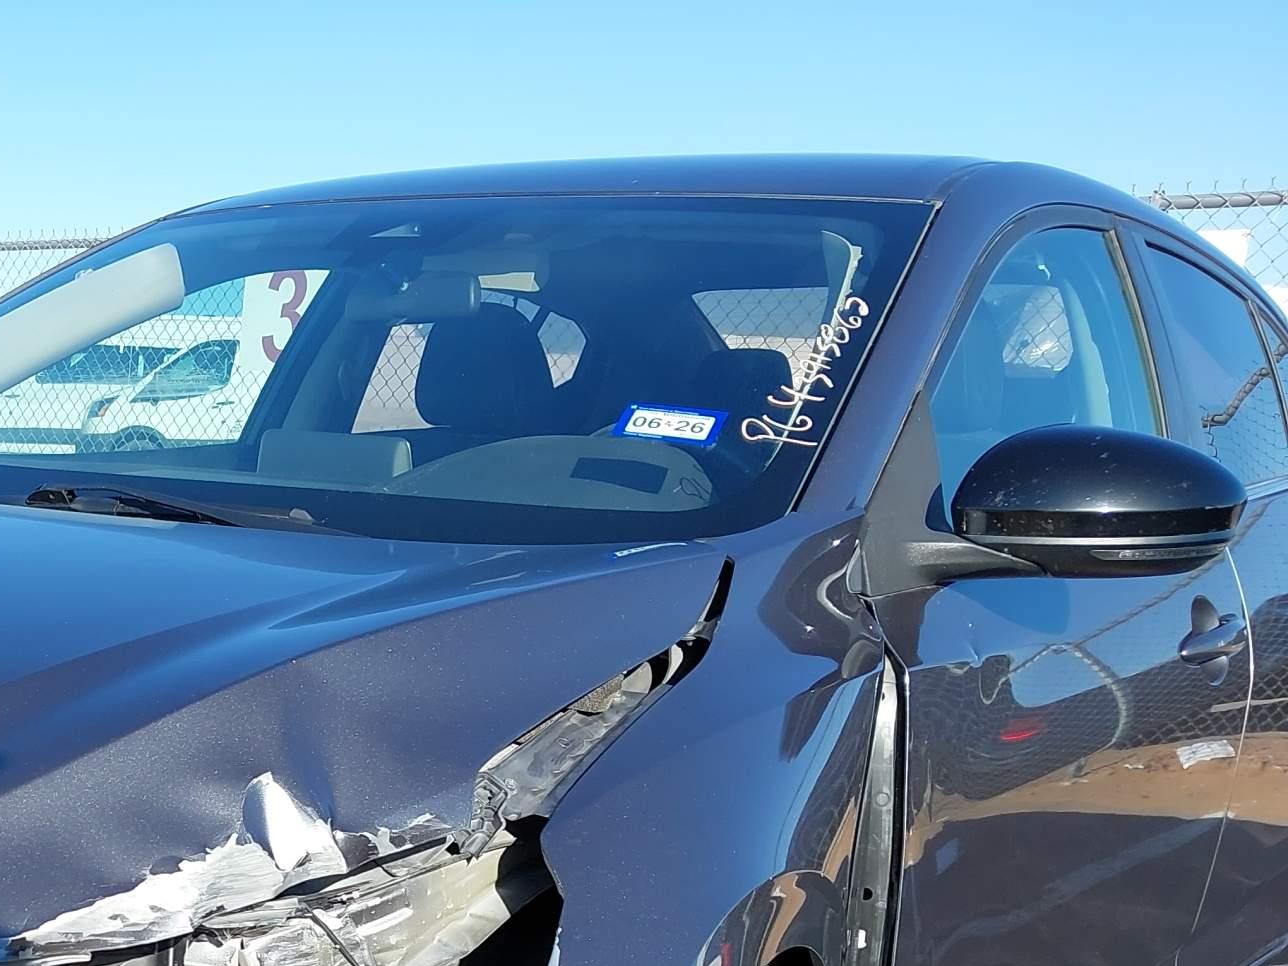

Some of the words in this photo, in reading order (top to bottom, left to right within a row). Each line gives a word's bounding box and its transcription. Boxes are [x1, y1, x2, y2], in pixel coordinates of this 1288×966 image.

[261, 269, 308, 363] 3
[632, 415, 663, 430] 06
[673, 419, 706, 434] 26
